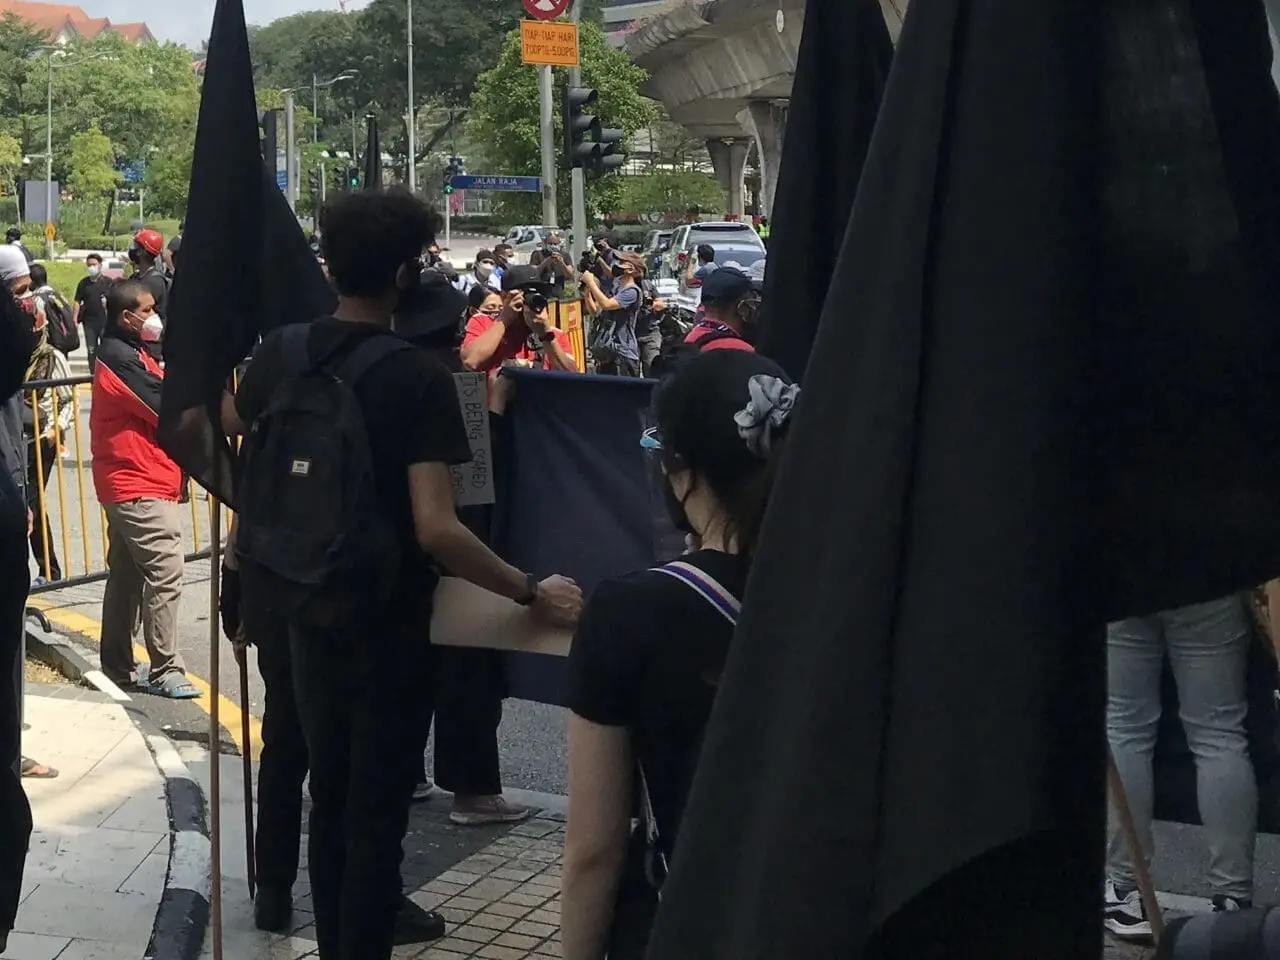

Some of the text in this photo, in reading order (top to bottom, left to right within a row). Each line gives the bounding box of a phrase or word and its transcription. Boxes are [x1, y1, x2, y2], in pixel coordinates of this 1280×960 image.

[473, 177, 517, 186] JALAN RAJA
[464, 402, 484, 441] BEING
